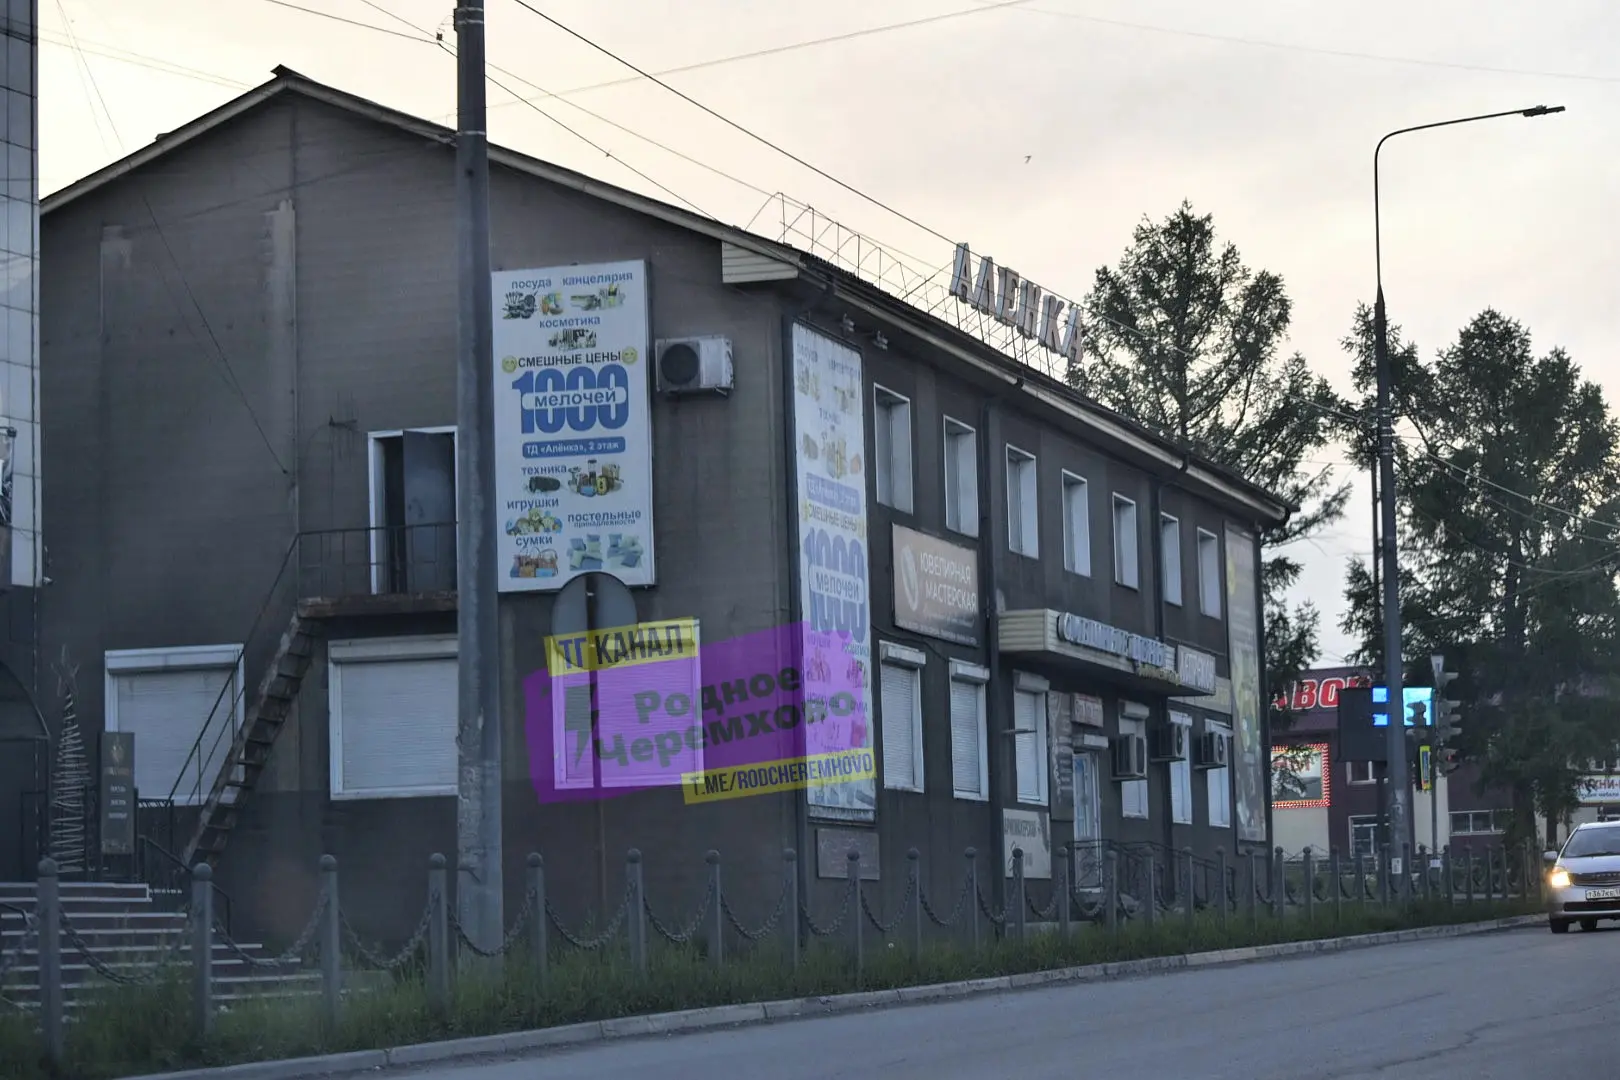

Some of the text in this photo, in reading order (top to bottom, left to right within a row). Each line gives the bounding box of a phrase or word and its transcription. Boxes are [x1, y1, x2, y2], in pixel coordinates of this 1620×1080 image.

[511, 272, 633, 290] посуда канцелярия
[949, 242, 1084, 366] АЛЕНКА
[539, 316, 601, 328] косметика
[518, 351, 621, 368] СМЕШНЫЕ ЦЕНЫ
[512, 364, 629, 434] 1000
[535, 388, 616, 408] мелочей
[526, 445, 539, 455] ТД
[588, 441, 596, 450] 2
[597, 440, 619, 450] этаж
[521, 464, 567, 476] техника
[506, 498, 559, 512] игрушки
[567, 510, 642, 523] постельные
[516, 535, 553, 548] сумки
[920, 552, 971, 585] ЮВЕЛИРНАЯ
[804, 527, 866, 642] 1000
[926, 580, 977, 612] МАСТЕРСКАЯ
